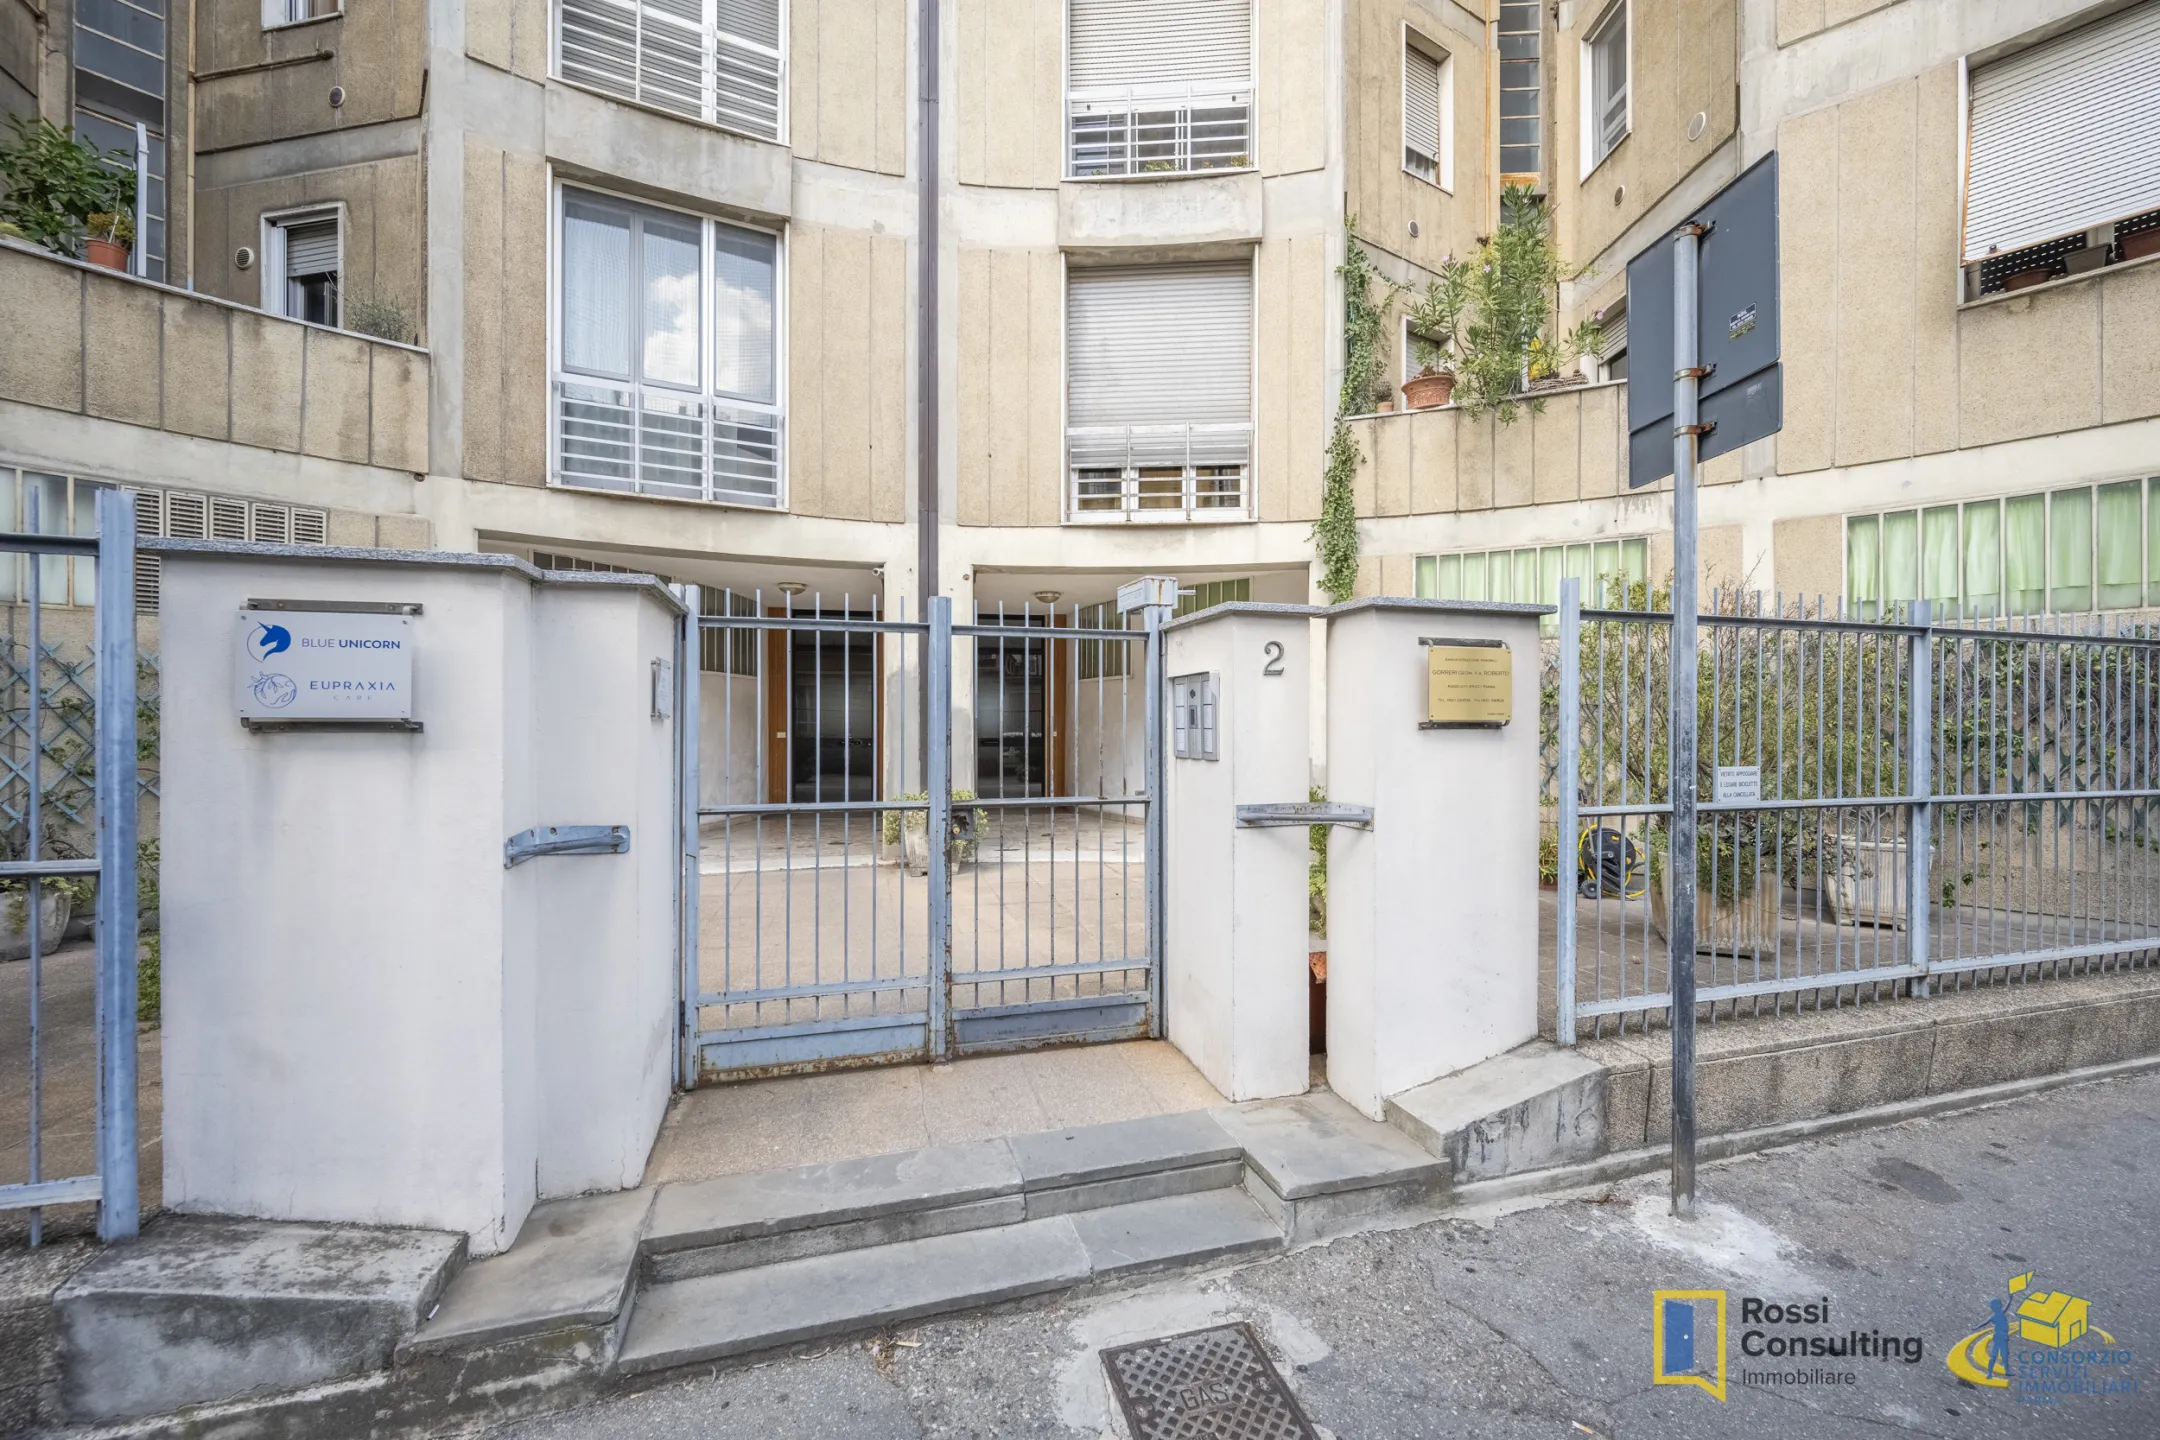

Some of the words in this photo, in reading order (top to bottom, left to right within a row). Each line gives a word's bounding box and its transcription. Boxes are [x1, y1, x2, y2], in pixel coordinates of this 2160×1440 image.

[301, 637, 335, 648] BLUE
[338, 639, 400, 649] UNICORN
[1262, 640, 1285, 676] 2
[309, 680, 396, 691] EUPRAXIA
[1180, 1382, 1230, 1411] GAS
